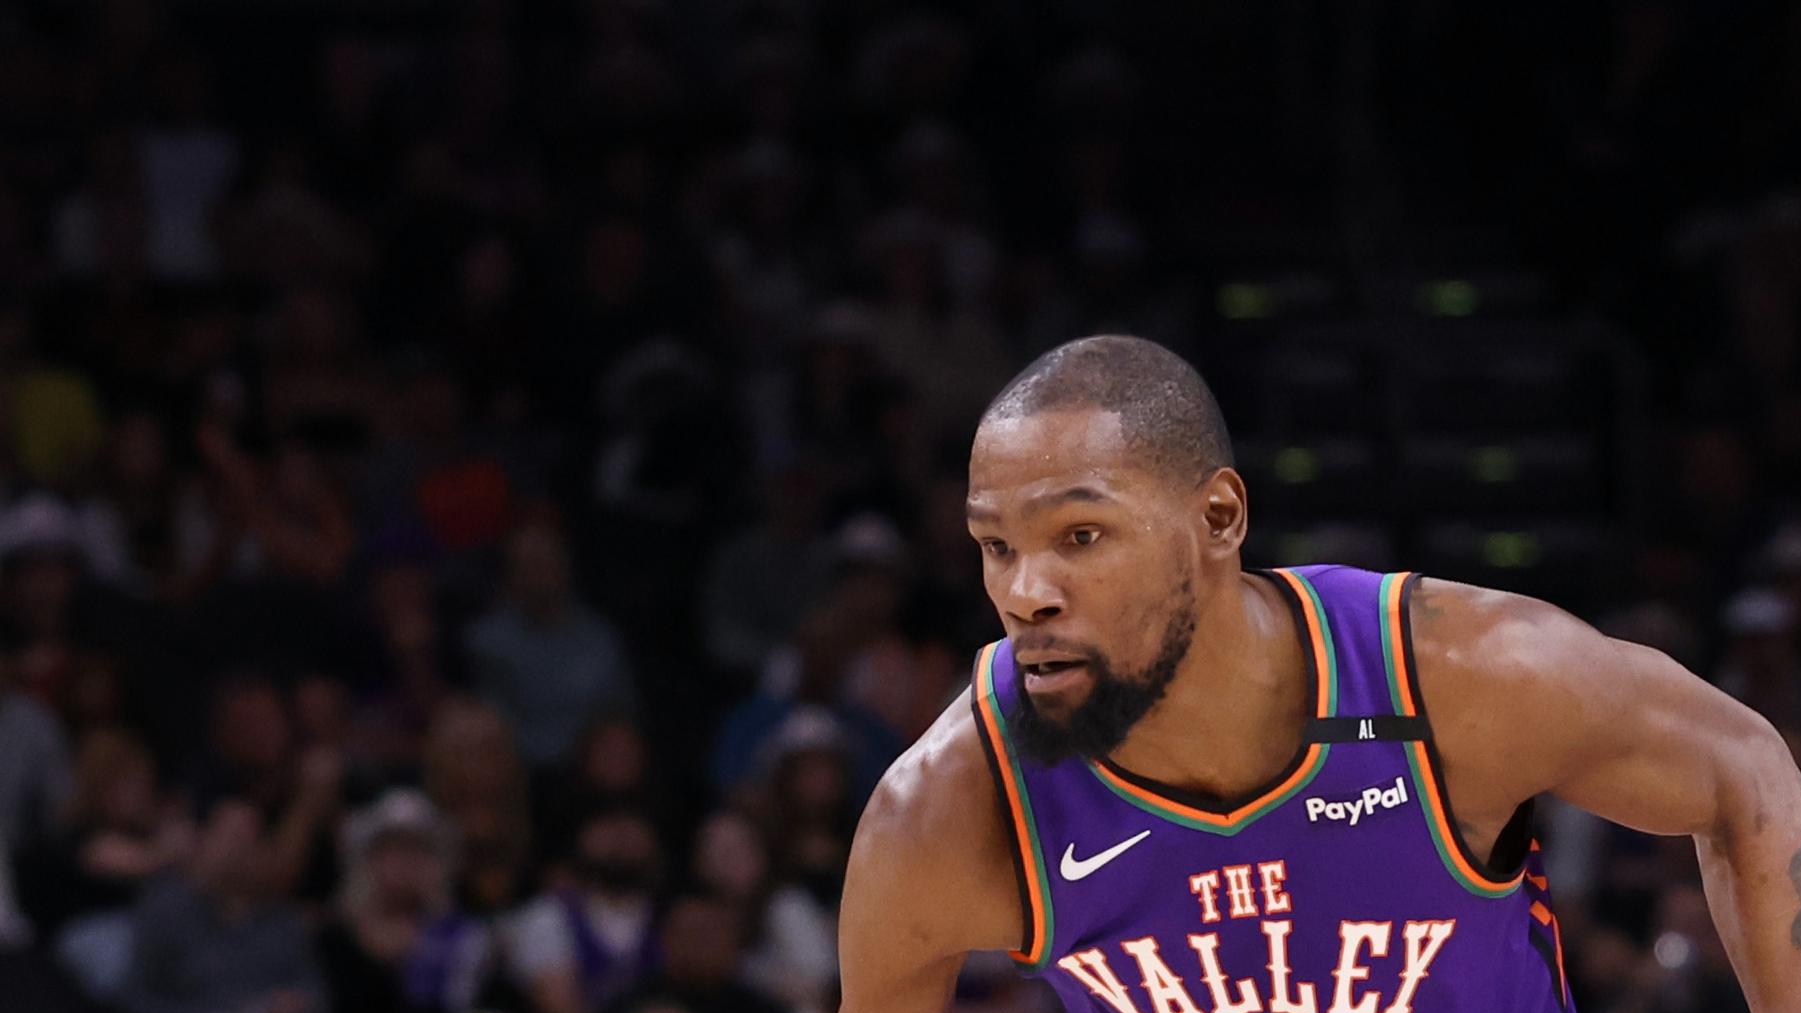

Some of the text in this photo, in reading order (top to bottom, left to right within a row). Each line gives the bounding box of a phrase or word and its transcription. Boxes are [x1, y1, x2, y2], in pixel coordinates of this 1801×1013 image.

[1358, 718, 1376, 740] AL
[1305, 776, 1409, 826] PayPal
[1190, 858, 1292, 923] THE
